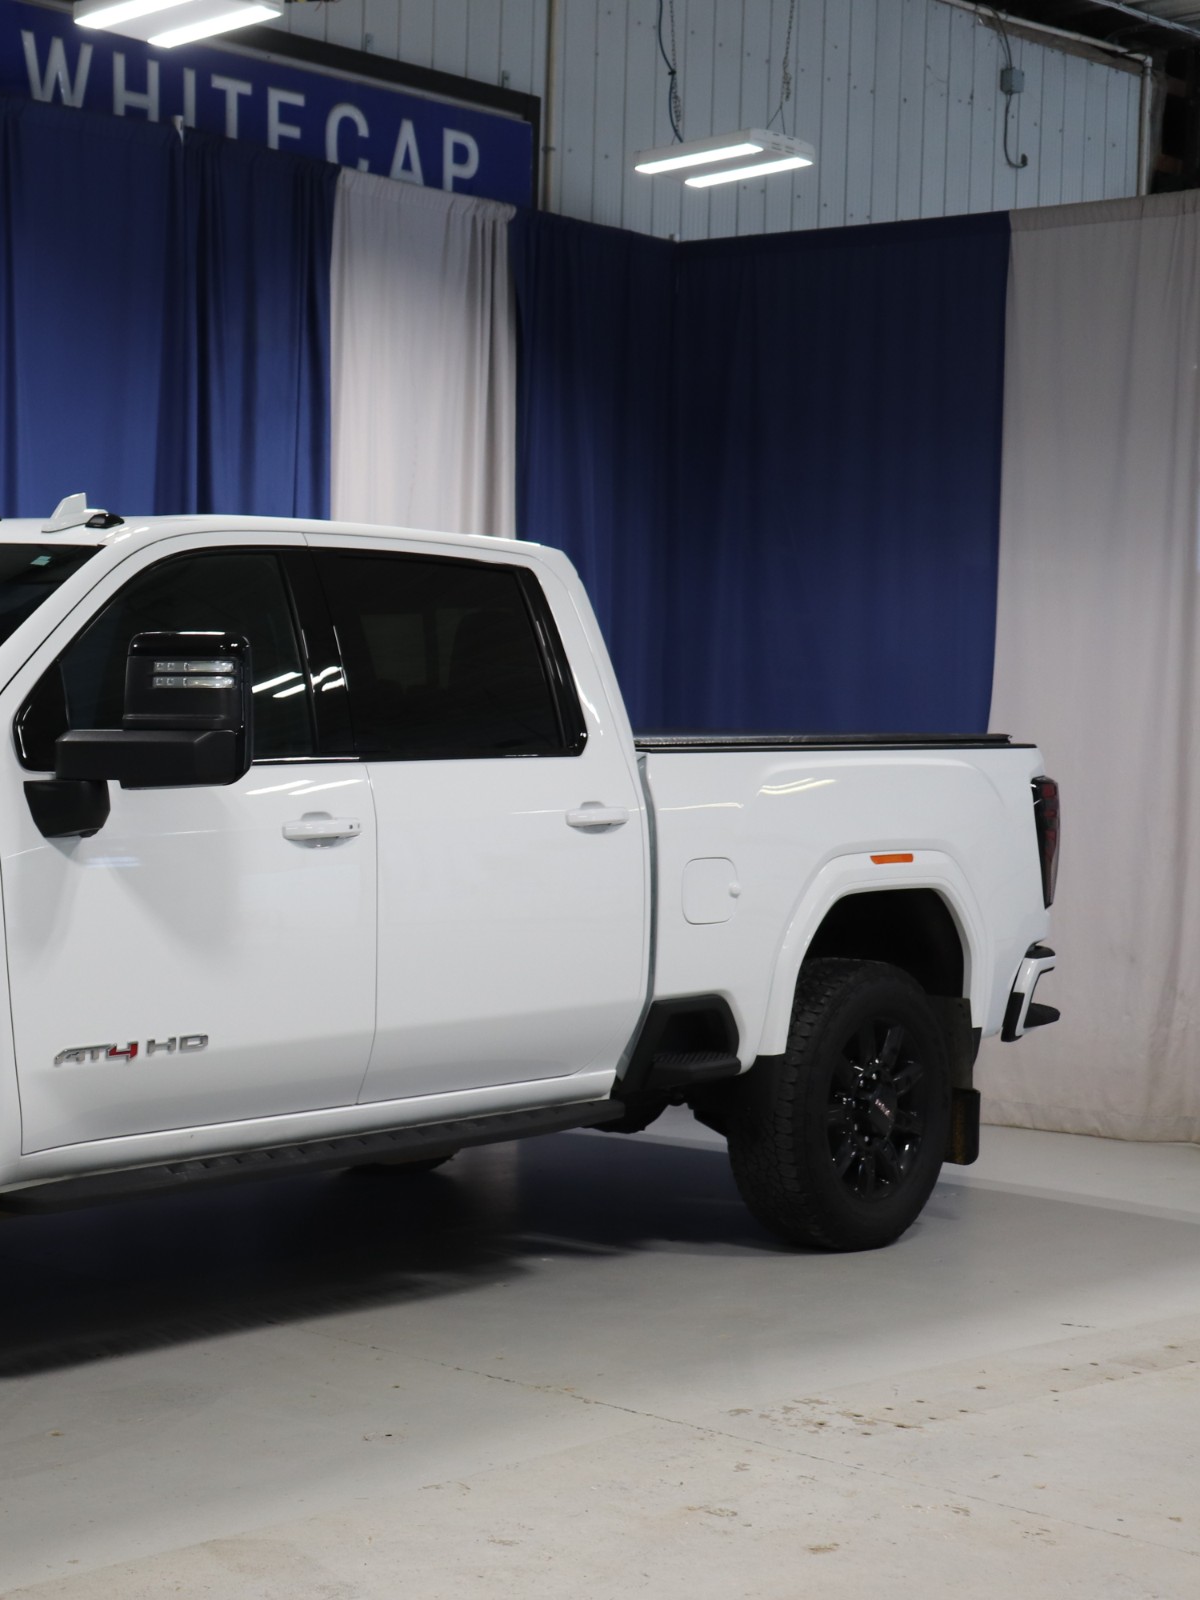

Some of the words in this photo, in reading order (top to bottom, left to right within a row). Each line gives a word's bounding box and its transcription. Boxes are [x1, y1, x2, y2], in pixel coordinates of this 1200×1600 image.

[20, 29, 481, 193] WHITECAP
[54, 1041, 139, 1067] AT4
[146, 1034, 209, 1057] HD
